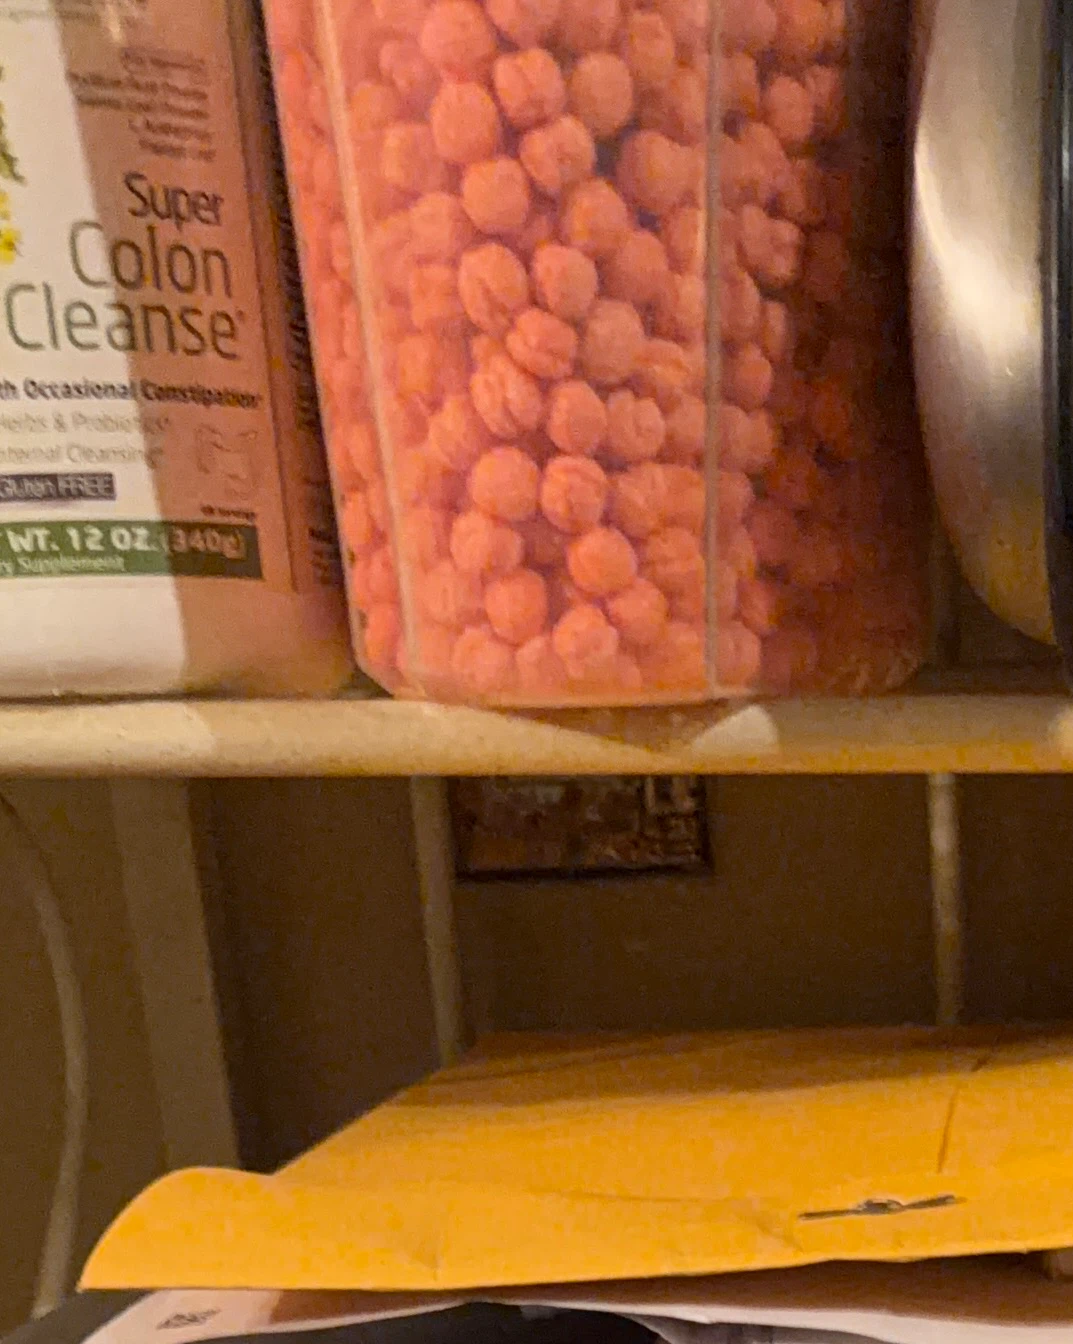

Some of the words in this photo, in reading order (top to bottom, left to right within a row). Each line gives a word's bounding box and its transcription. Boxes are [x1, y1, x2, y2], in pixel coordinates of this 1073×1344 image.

[124, 171, 224, 231] Super
[70, 221, 231, 298] Colon
[7, 282, 240, 360] Cleanse
[23, 377, 137, 401] Occasional
[140, 378, 260, 408] Constipation
[67, 526, 105, 551] 12
